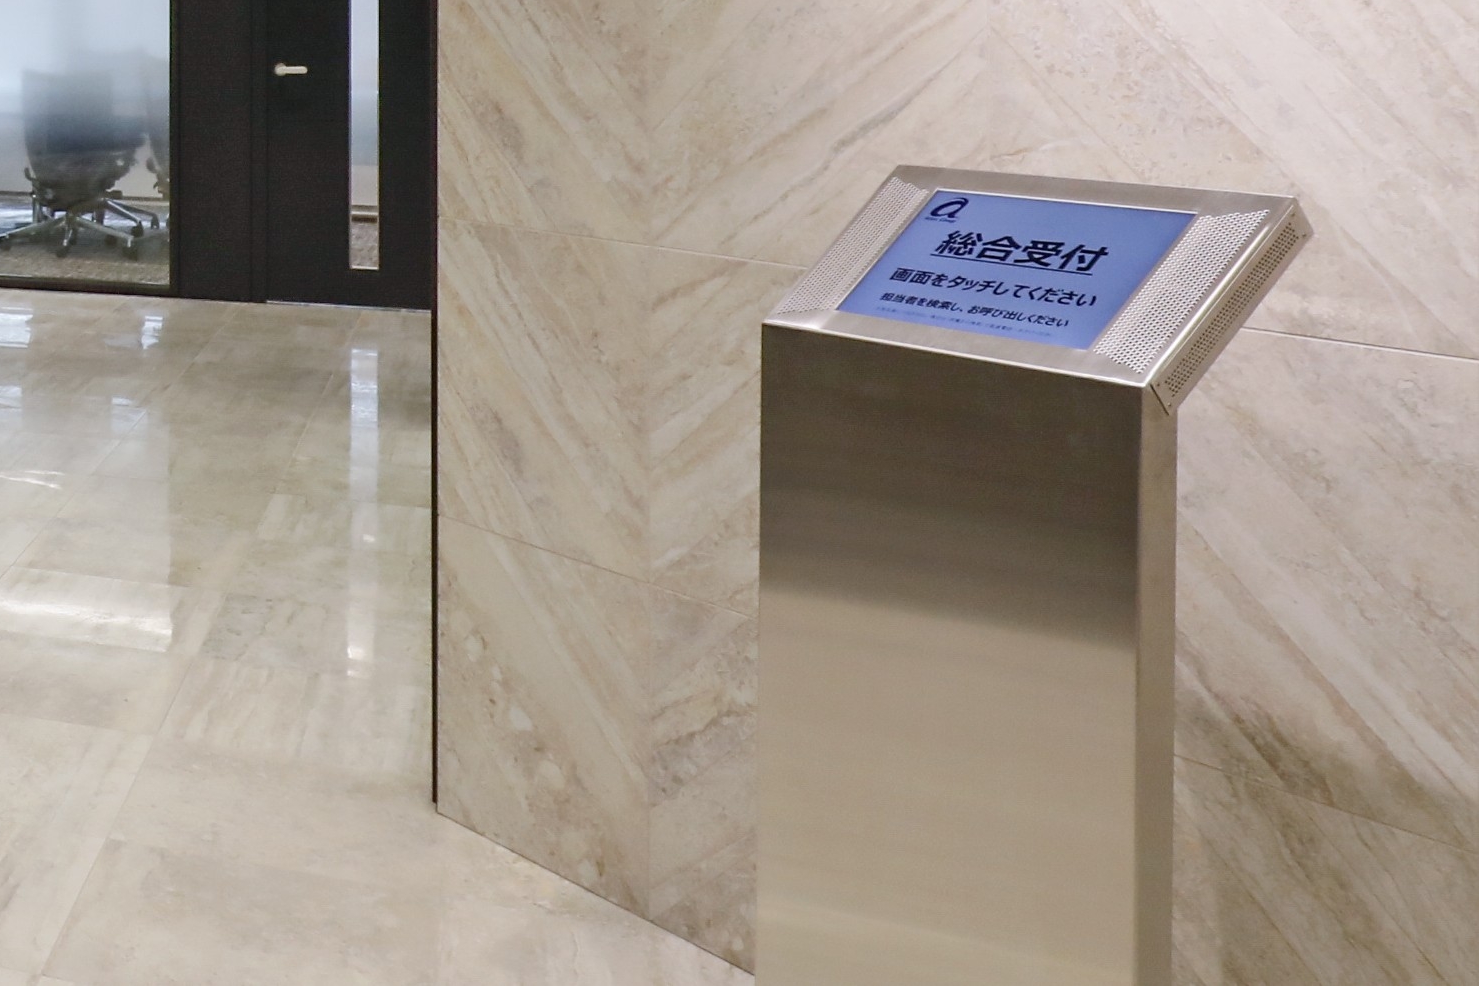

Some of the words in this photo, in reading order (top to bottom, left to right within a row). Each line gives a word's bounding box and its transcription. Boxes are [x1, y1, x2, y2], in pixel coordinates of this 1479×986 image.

[934, 230, 1109, 272] 総合受付
[889, 267, 1097, 307] 画面をタッチしてください
